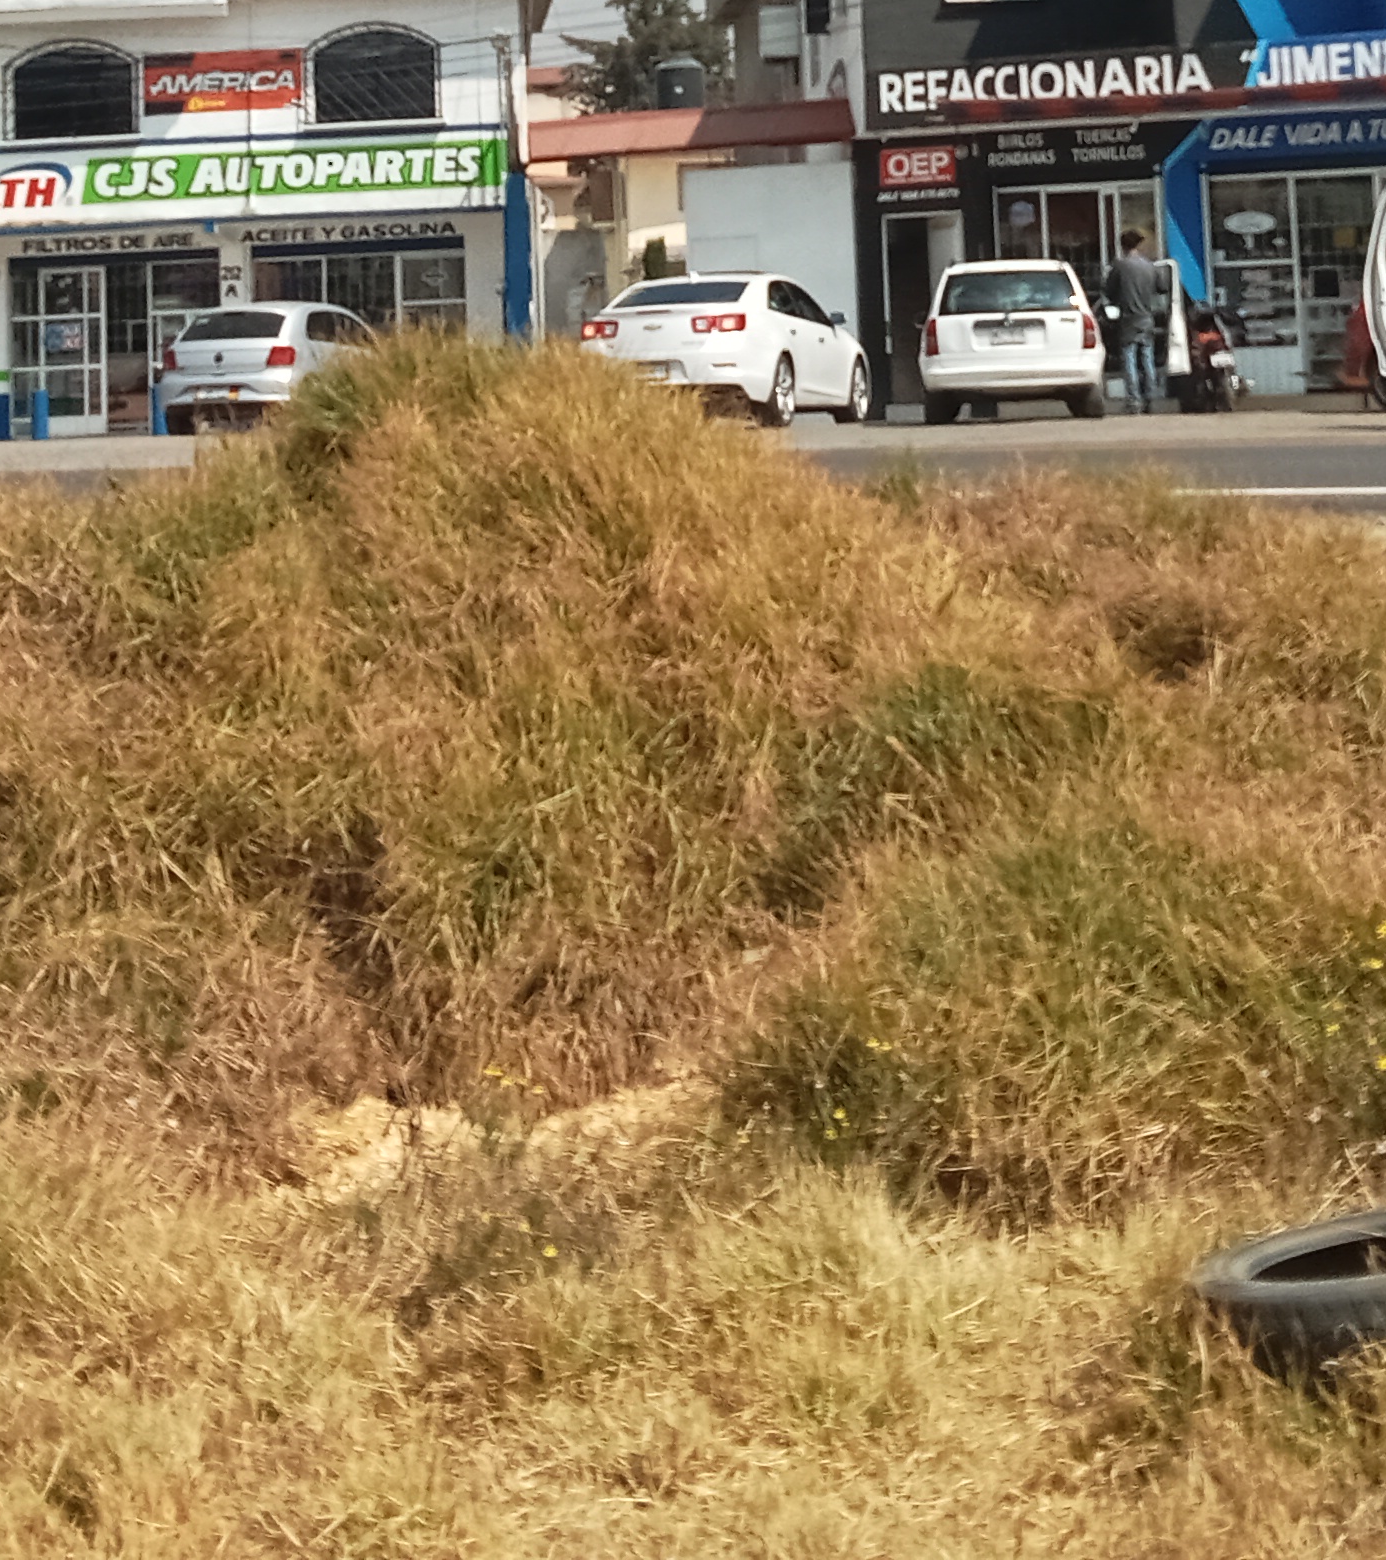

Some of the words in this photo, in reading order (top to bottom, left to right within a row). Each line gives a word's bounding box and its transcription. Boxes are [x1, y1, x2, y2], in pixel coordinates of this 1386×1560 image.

[878, 52, 1213, 113] REFACCIONARIA
[1209, 125, 1279, 150] DALE
[1284, 121, 1342, 146] VIDA
[1346, 119, 1365, 143] A
[92, 156, 179, 199] CJS
[188, 146, 482, 194] AUTOPARTES
[886, 150, 951, 177] OEP
[22, 235, 113, 254] FILTROS
[119, 234, 146, 250] DE
[241, 226, 314, 242] ACEITE
[320, 225, 337, 240] Y
[341, 221, 457, 239] GASOLINA
